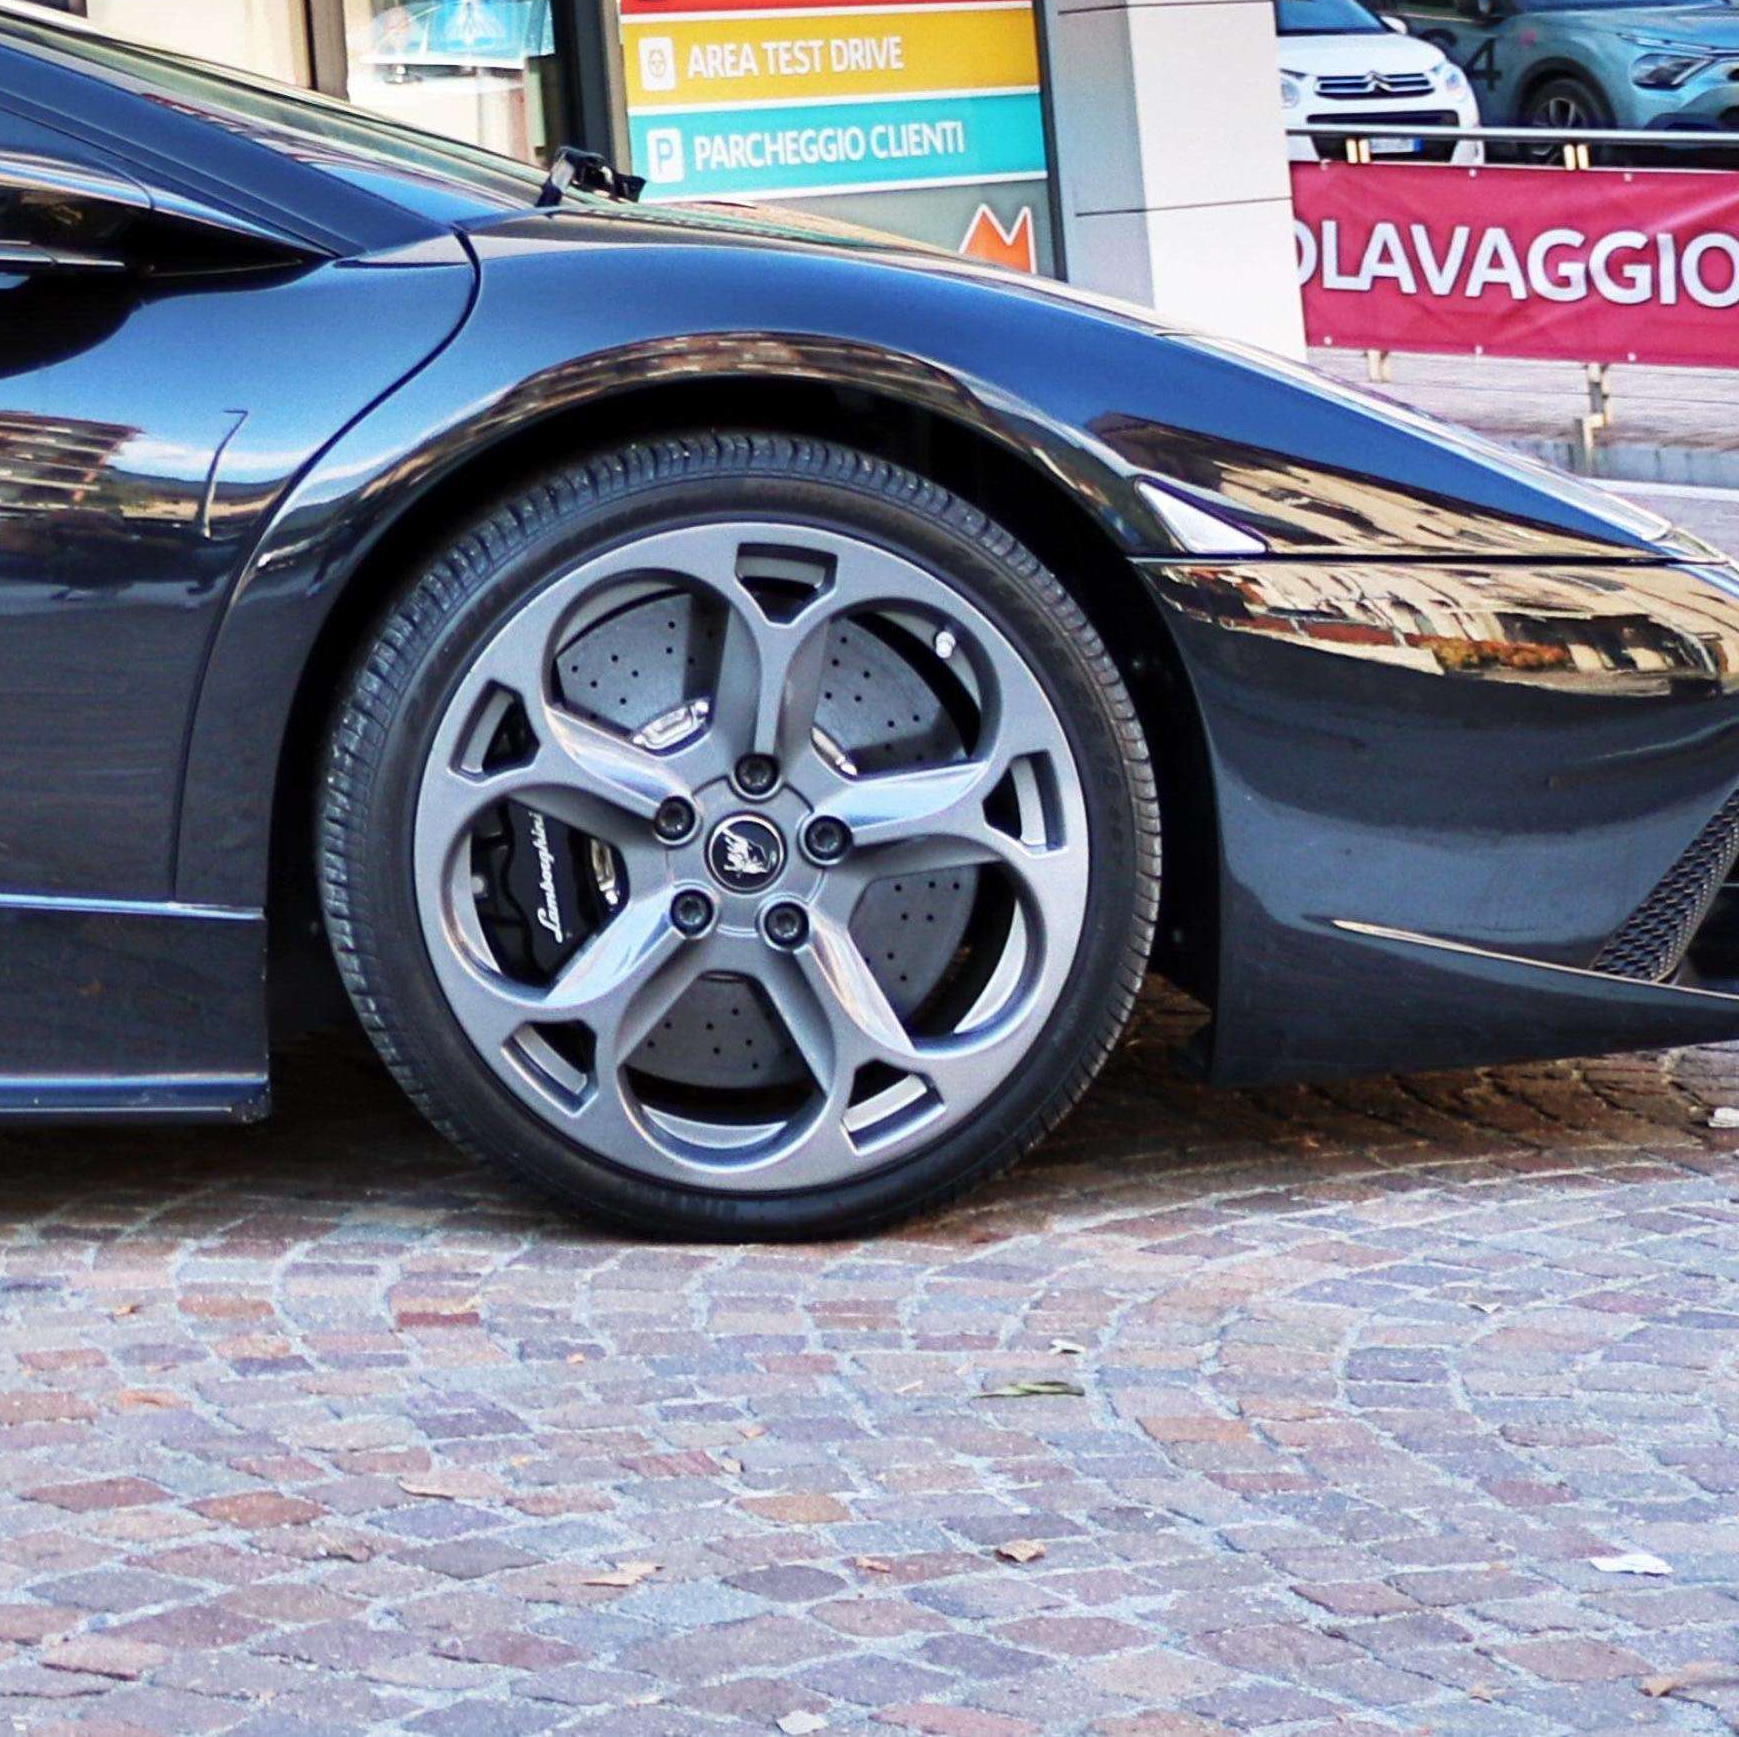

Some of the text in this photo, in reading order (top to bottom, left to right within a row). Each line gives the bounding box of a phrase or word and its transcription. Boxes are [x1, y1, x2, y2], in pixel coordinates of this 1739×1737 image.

[688, 36, 904, 78] AREA TEST DRIVE
[694, 127, 865, 171] PARCHEGGIO
[870, 120, 965, 158] CLIENTI
[527, 811, 563, 944] Lamborghini
